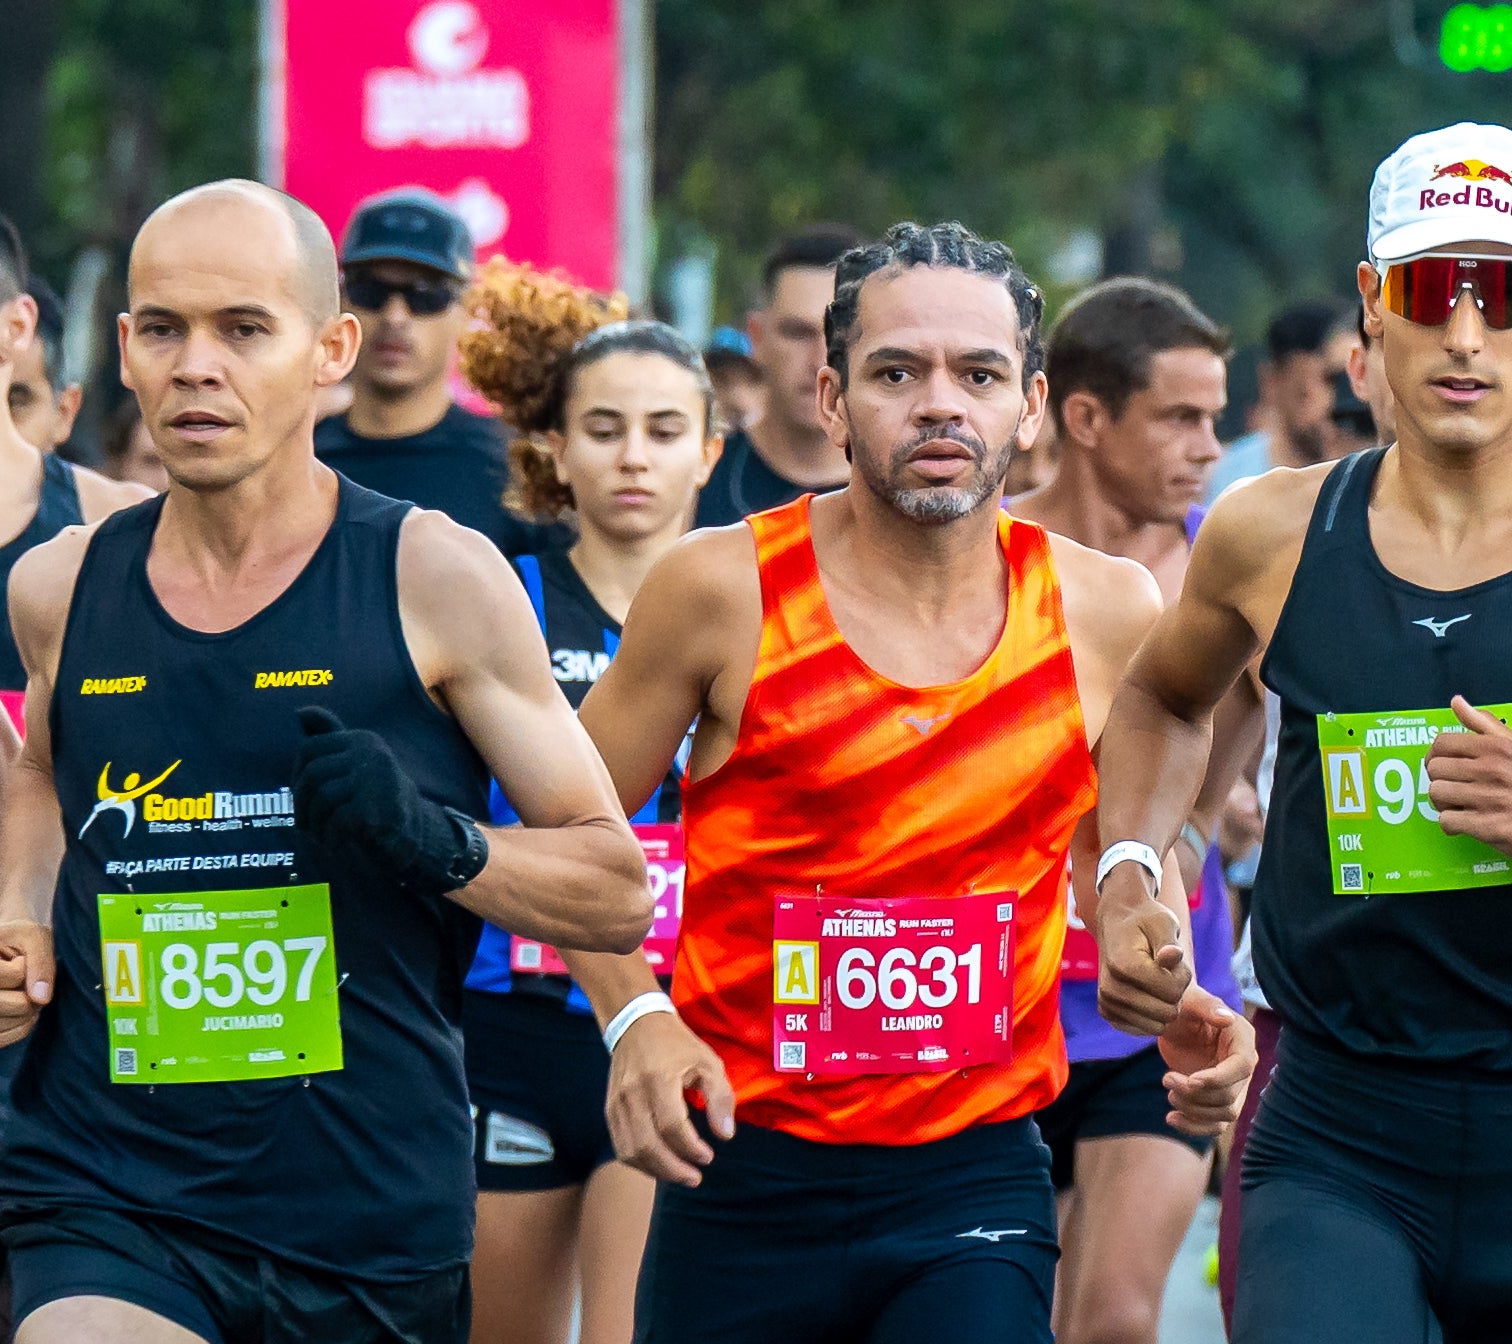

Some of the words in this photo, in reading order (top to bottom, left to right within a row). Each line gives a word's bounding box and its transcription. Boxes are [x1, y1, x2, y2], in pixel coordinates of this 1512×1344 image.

[1419, 184, 1472, 212] Red
[255, 669, 332, 689] RAMATEX
[1365, 726, 1439, 748] ATHENAS
[1338, 759, 1361, 808] A
[1374, 758, 1441, 825] 95
[143, 786, 295, 822] GoodRunni
[251, 816, 295, 829] wellne
[1337, 834, 1363, 852] 10K
[145, 857, 191, 873] PARTE
[192, 854, 238, 870] DESTA
[142, 911, 217, 933] ATHENAS
[821, 918, 897, 937] ATHENAS
[115, 949, 135, 997] A
[159, 936, 327, 1010] 8597
[785, 950, 809, 995] A
[836, 943, 982, 1010] 6631
[201, 1013, 284, 1032] JUCIMARIO
[785, 1014, 808, 1031] 5K
[881, 1014, 943, 1032] LEANDRO
